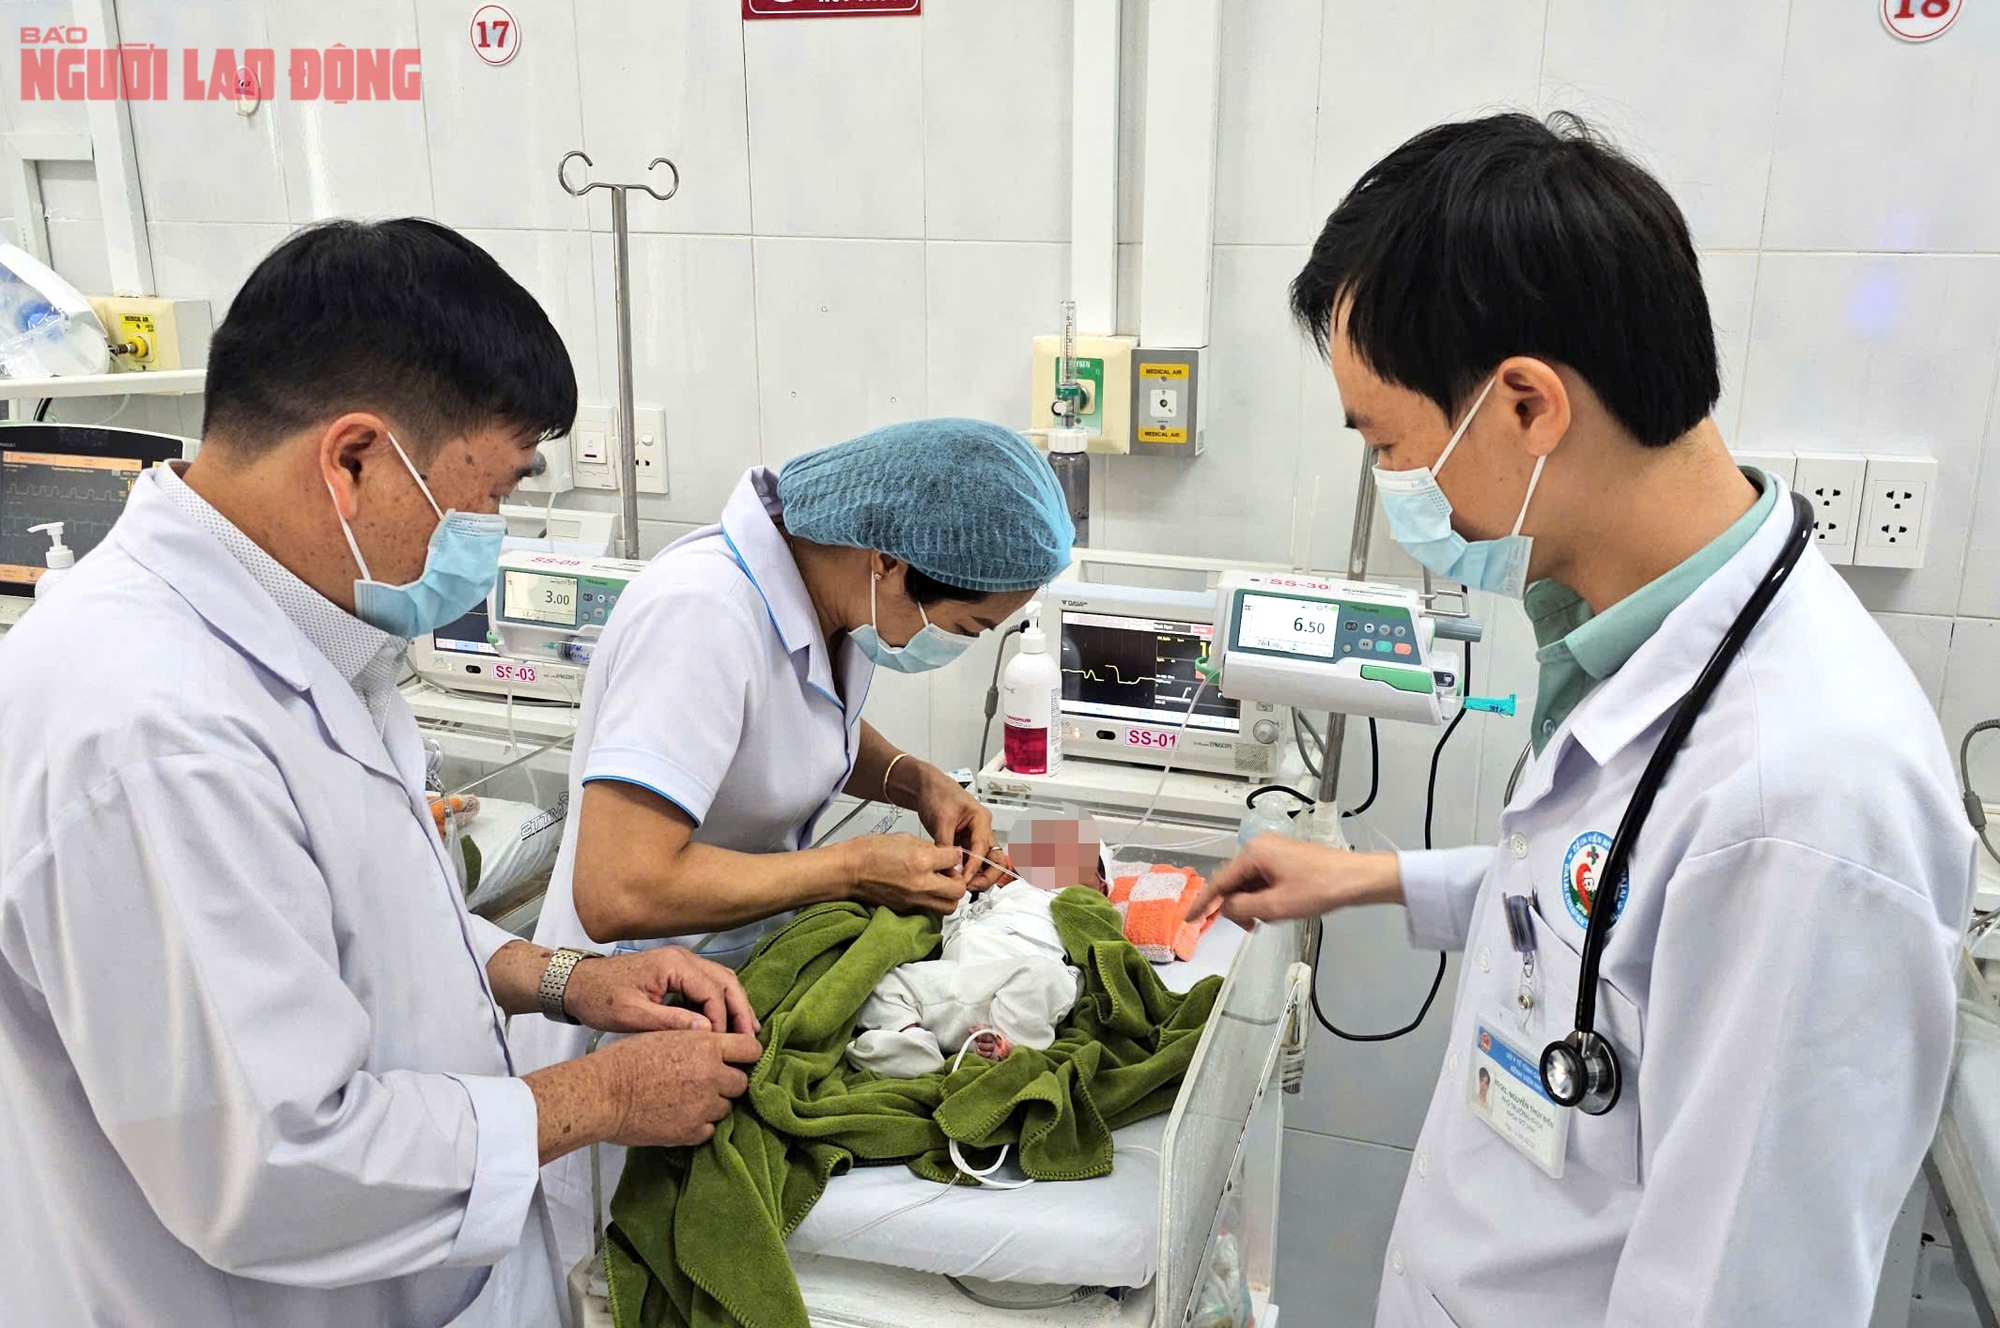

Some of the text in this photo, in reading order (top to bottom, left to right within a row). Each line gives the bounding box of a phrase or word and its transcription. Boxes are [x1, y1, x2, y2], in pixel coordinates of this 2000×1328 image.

[477, 21, 509, 48] 17
[531, 556, 581, 566] SS-09
[1269, 578, 1329, 590] SS-30
[545, 590, 570, 606] 3.00
[1293, 616, 1325, 634] 6.50
[495, 665, 536, 682] SS-03
[1128, 729, 1177, 748] SS-01
